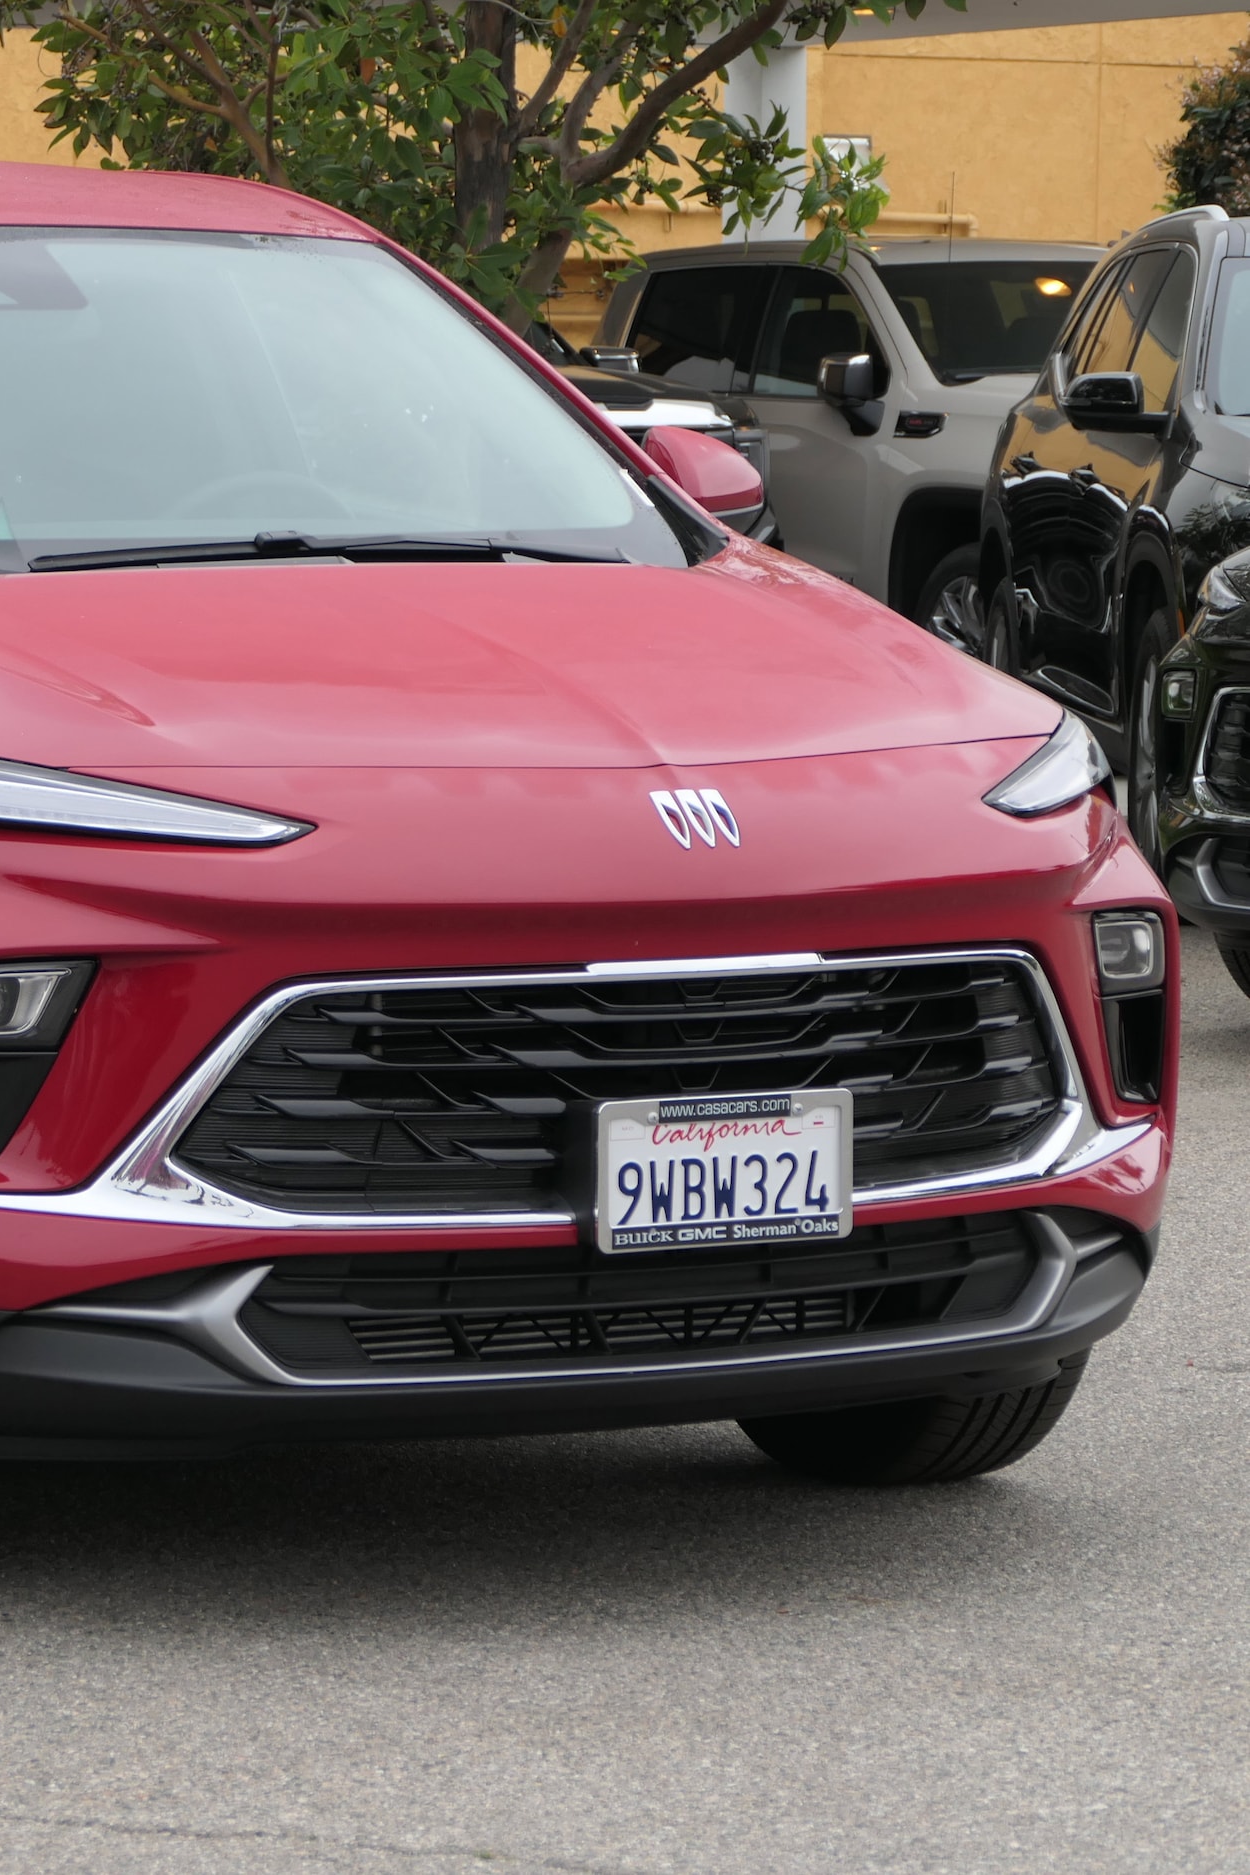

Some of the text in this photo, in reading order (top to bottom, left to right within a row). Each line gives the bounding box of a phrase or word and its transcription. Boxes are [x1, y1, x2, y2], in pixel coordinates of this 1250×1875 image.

[661, 1097, 790, 1118] www.casacars.com
[652, 1118, 801, 1152] California
[617, 1150, 829, 1225] 9WBW324
[615, 1218, 839, 1246] BUICK GMC Sherman Oaks
